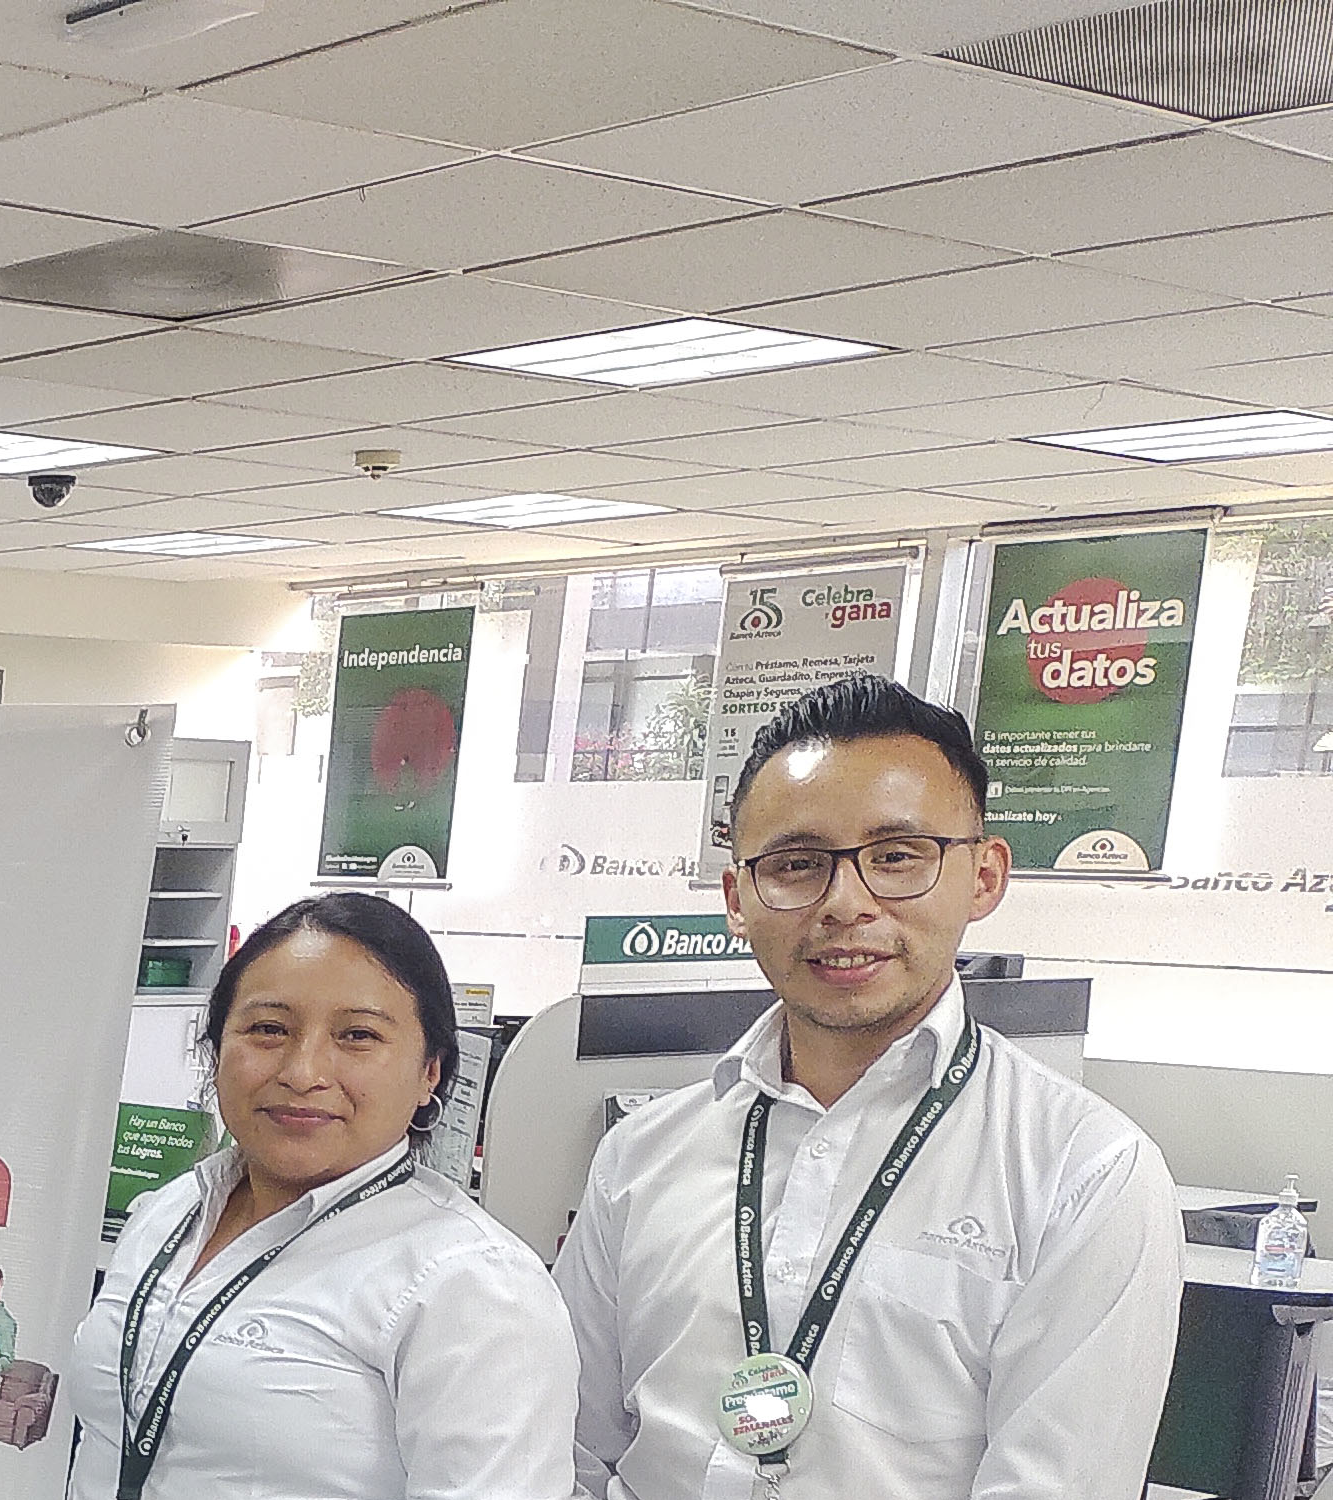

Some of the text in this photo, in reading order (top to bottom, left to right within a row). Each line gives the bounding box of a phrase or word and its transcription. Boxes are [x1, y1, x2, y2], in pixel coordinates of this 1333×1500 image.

[801, 584, 874, 607] Celebra
[830, 601, 892, 629] gana
[996, 590, 1184, 636] Actualiza
[342, 643, 463, 670] Independencia
[843, 654, 875, 667] Tarjeta
[1028, 639, 1062, 659] tus
[1041, 650, 1158, 689] datos
[721, 702, 777, 714] SORTEOS
[983, 743, 1011, 754] datos
[1013, 742, 1078, 753] actualizados
[589, 855, 662, 876] Banco
[661, 929, 727, 956] Banco
[158, 1118, 187, 1133] Banco
[893, 1101, 944, 1170] Banco Azteca
[140, 1133, 167, 1146] apoya
[167, 1135, 194, 1149] todos
[741, 1151, 755, 1186] Azteca
[831, 1207, 877, 1284] Banco Azteca
[739, 1223, 753, 1297] Banco Azteca
[197, 1275, 250, 1334] Banco Azteca
[795, 1323, 820, 1364] Azteca
[147, 1370, 178, 1438] Banco Azteca
